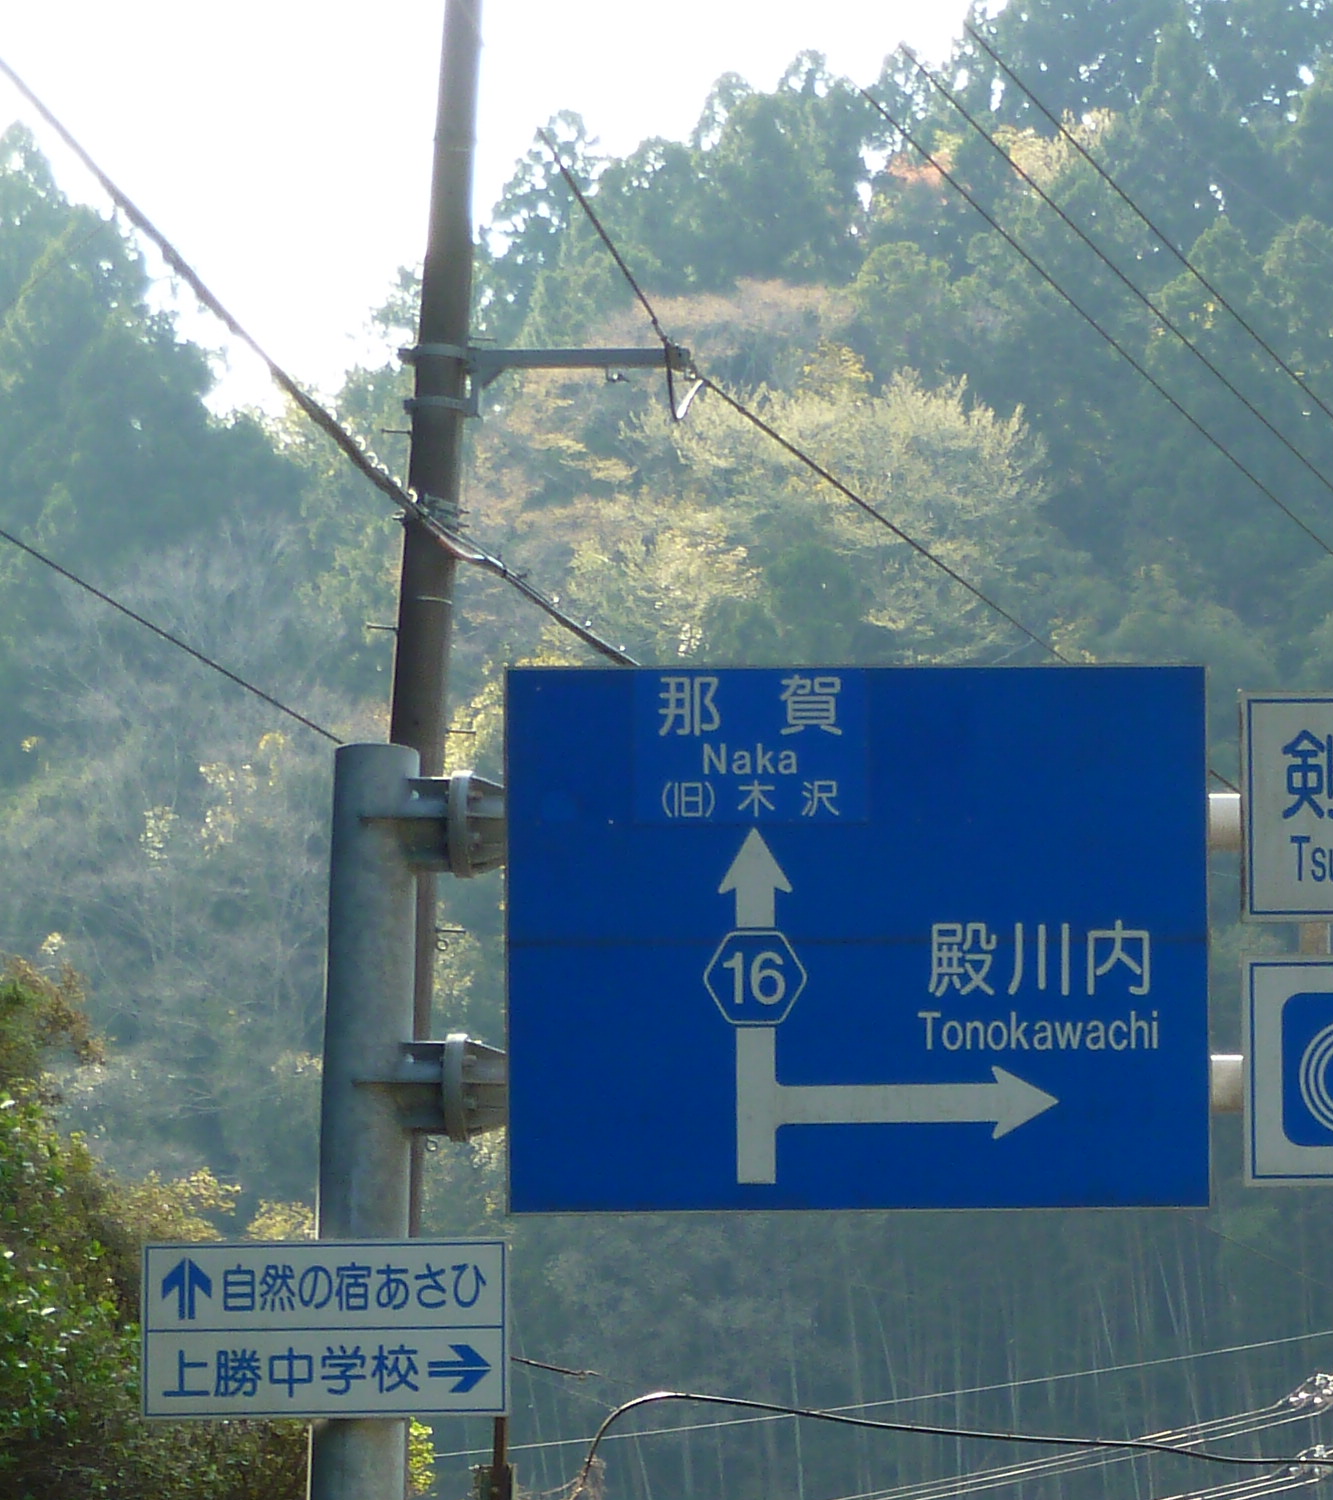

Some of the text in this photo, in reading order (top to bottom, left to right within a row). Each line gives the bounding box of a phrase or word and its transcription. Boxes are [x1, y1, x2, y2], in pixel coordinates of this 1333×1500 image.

[702, 742, 798, 775] Naka
[721, 951, 786, 1006] 16
[927, 919, 1152, 997] 殿川内
[917, 1010, 1159, 1051] Tonokawachi
[222, 1262, 488, 1312] 自然の宿あさひ
[162, 1344, 419, 1398] 上勝中学校
